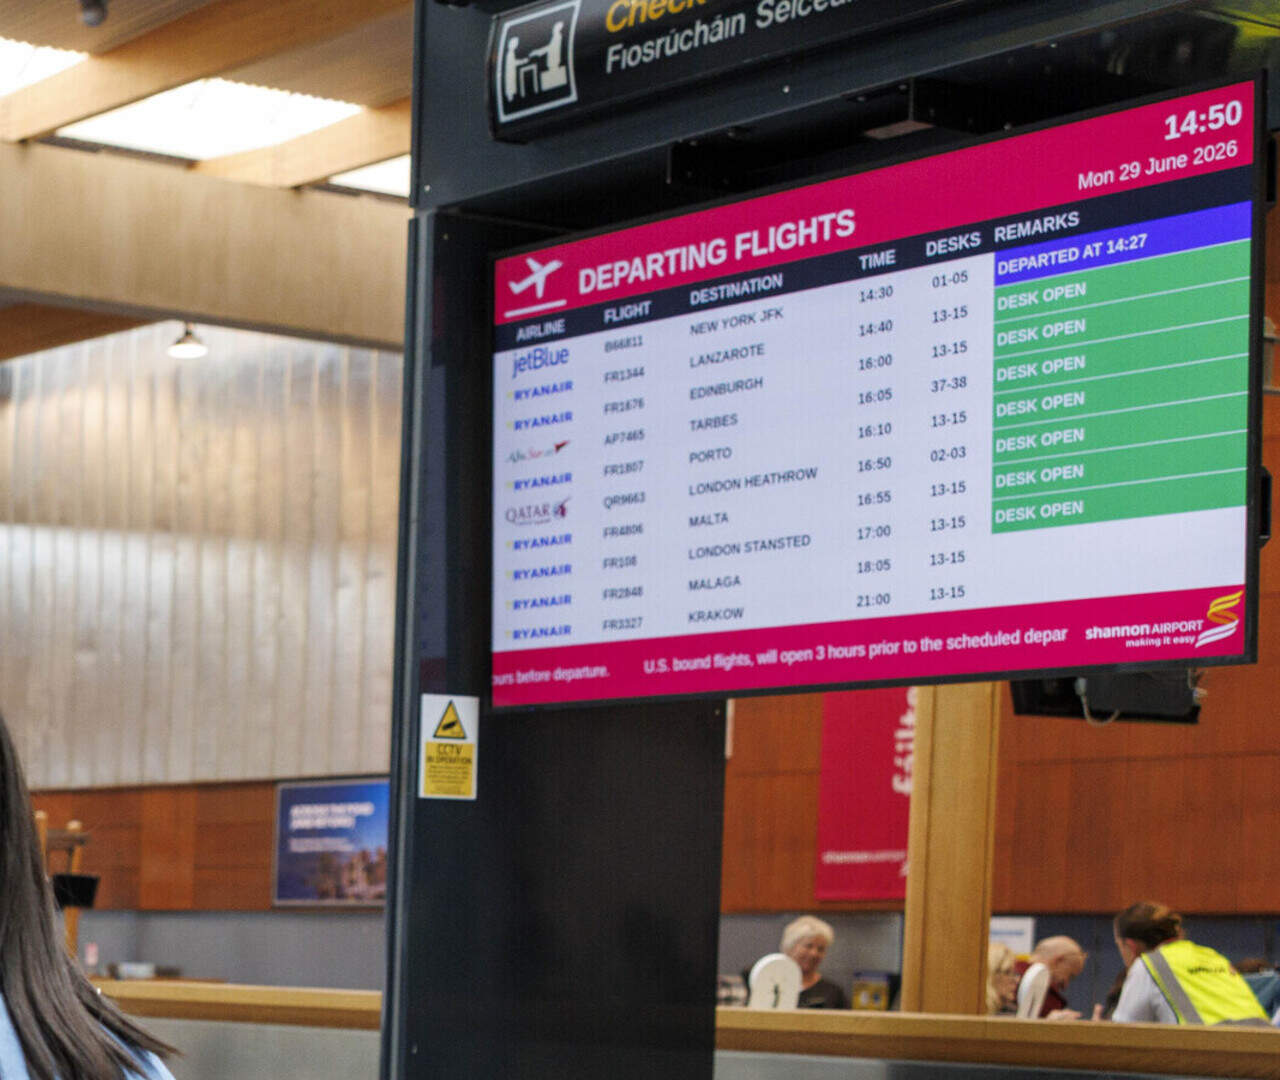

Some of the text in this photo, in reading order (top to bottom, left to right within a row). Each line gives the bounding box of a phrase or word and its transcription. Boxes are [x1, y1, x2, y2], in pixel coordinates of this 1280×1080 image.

[606, 0, 706, 32] Chec
[1164, 100, 1242, 140] 14:50
[1078, 140, 1238, 190] Mon 29 June 2026
[516, 211, 1080, 342] AIRLINE FLIGHT DESTINATION TIME DESKS REMARKS
[579, 209, 856, 294] DEPARTING FLIGHTS
[512, 347, 569, 379] jetBlue
[690, 320, 718, 336] NEW
[721, 312, 756, 331] YORK
[760, 307, 784, 324] JFK
[859, 285, 893, 303] 14:30
[932, 270, 968, 288] 01-05
[998, 247, 1079, 275] DEPARTED
[1083, 242, 1103, 259] AT
[1106, 234, 1148, 254] 14:27
[514, 380, 573, 401] RYANAIR
[690, 343, 765, 368] LANZAROTE
[859, 319, 893, 337] 14:40
[932, 305, 968, 323] 13-15
[997, 291, 1039, 311] DESK
[1043, 282, 1087, 303] OPEN
[514, 411, 573, 431] RYANAIR
[690, 377, 764, 400] EDINBURGH
[859, 354, 892, 371] 16:00
[932, 340, 968, 358] 13-15
[997, 328, 1038, 346] DESK
[1042, 319, 1086, 338] OPEN
[690, 413, 738, 431] TARBES
[858, 388, 892, 405] 16:05
[931, 376, 967, 393] 37-38
[997, 364, 1038, 382] DESK
[1042, 355, 1086, 374] OPEN
[505, 504, 550, 522] QATAR
[689, 478, 741, 496] LONDON
[744, 467, 818, 489] HEATHROW
[858, 456, 892, 473] 16:50
[930, 446, 966, 463] 02-03
[996, 435, 1037, 453] DESK
[1041, 428, 1085, 447] OPEN
[513, 472, 572, 491] RYANAIR
[690, 446, 732, 464] PORTO
[858, 422, 892, 439] 16:10
[931, 411, 967, 428] 13-15
[996, 399, 1038, 418] DESK
[1041, 391, 1085, 411] OPEN
[513, 533, 572, 550] RYANAIR
[688, 512, 729, 527] MALTA
[858, 491, 891, 507] 16:55
[931, 481, 966, 497] 13-15
[995, 470, 1036, 488] DESK
[1040, 464, 1084, 482] OPEN
[513, 563, 572, 580] RYANAIR
[688, 544, 741, 560] LONDON
[744, 534, 811, 554] STANSTED
[857, 525, 891, 541] 17:00
[930, 516, 966, 532] 13-15
[995, 506, 1036, 524] DESK
[1040, 500, 1084, 518] OPEN
[513, 594, 572, 611] RYANAIR
[688, 576, 741, 591] MALAGA
[857, 559, 891, 574] 18:05
[930, 550, 965, 566] 13-15
[513, 624, 572, 640] RYANAIR
[688, 607, 744, 624] KRAKOW
[856, 593, 890, 608] 21:00
[929, 585, 965, 600] 13-15
[643, 627, 1068, 674] U.S. bound flights, will open 3 hours prior to the scheduled depar
[1085, 619, 1204, 640] shannon AIRPORT
[1126, 635, 1196, 648] making it easy
[516, 669, 551, 684] before
